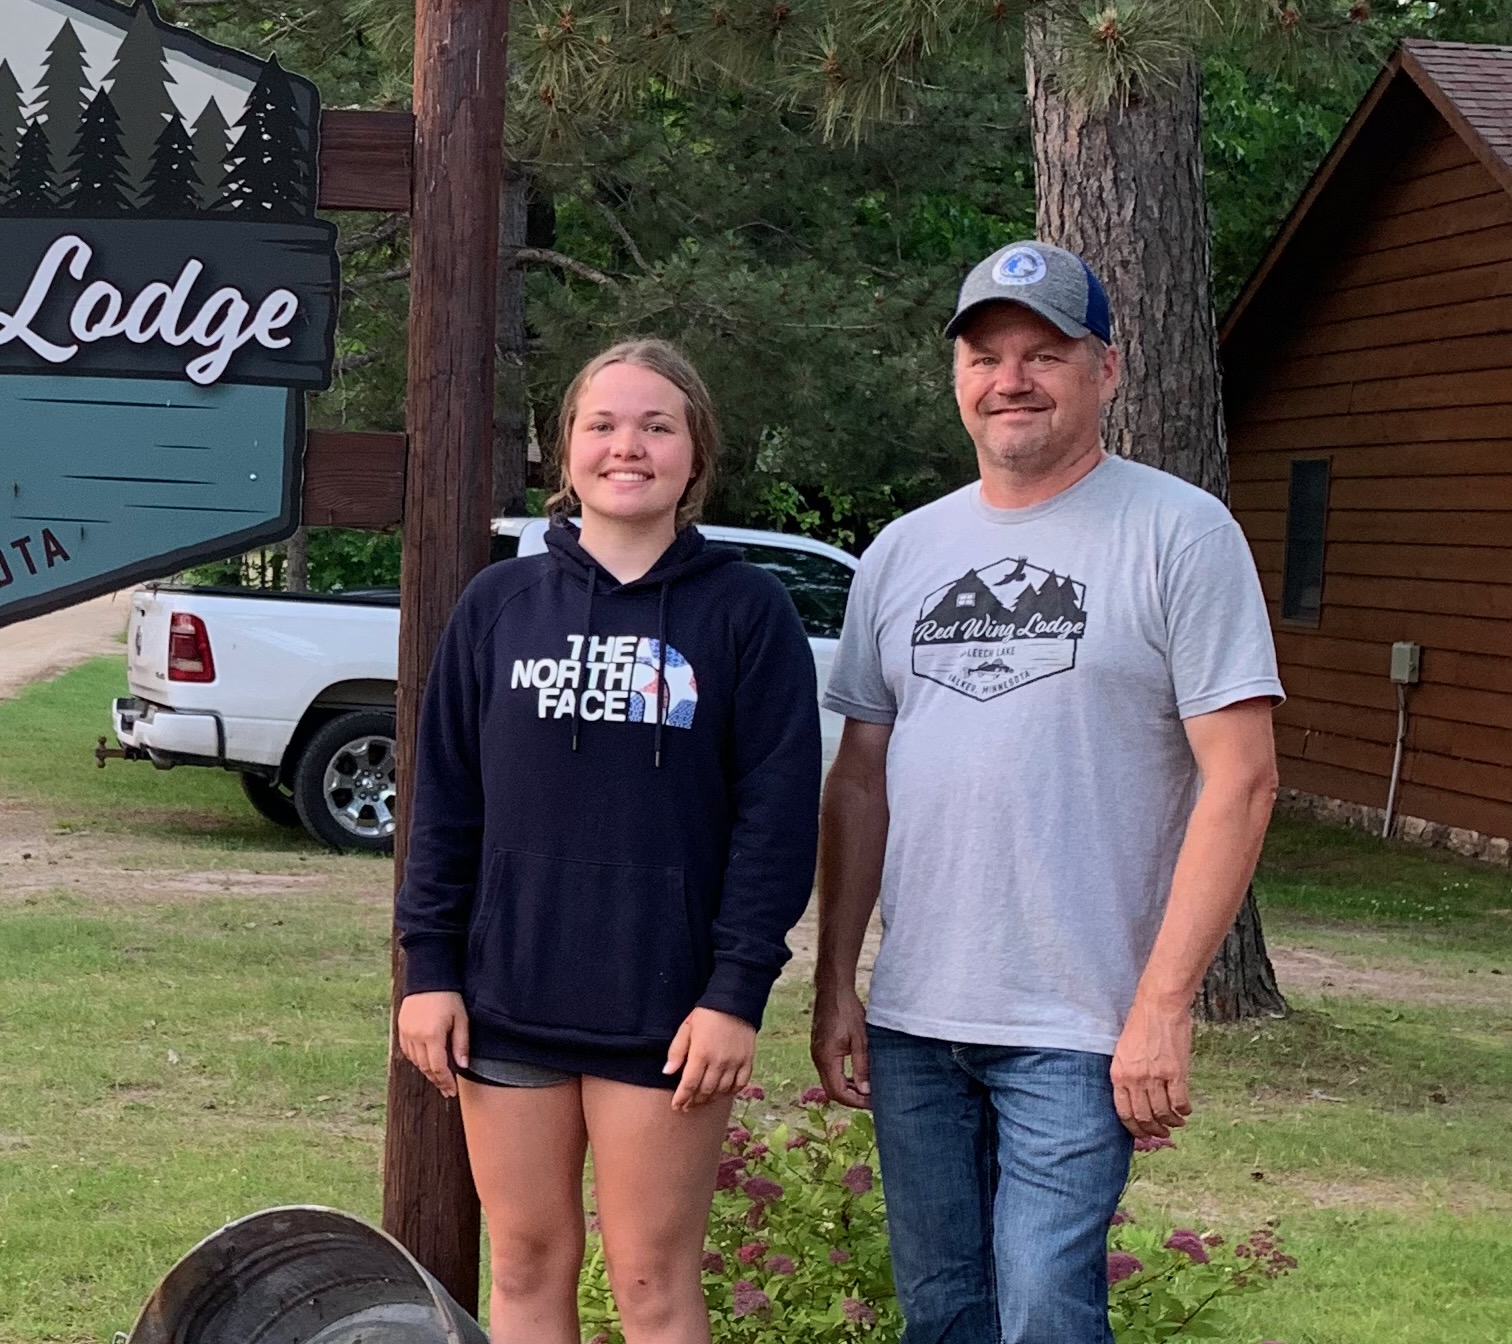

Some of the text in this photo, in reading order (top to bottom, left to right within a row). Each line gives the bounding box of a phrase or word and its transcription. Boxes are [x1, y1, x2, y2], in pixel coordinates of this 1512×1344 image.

[914, 611, 1085, 644] Red Wing Lodge
[566, 634, 638, 664] THE
[966, 647, 994, 658] LEECH
[510, 657, 633, 691] NORTH
[981, 670, 1031, 694] MINNESOTA
[537, 688, 629, 723] FACE
